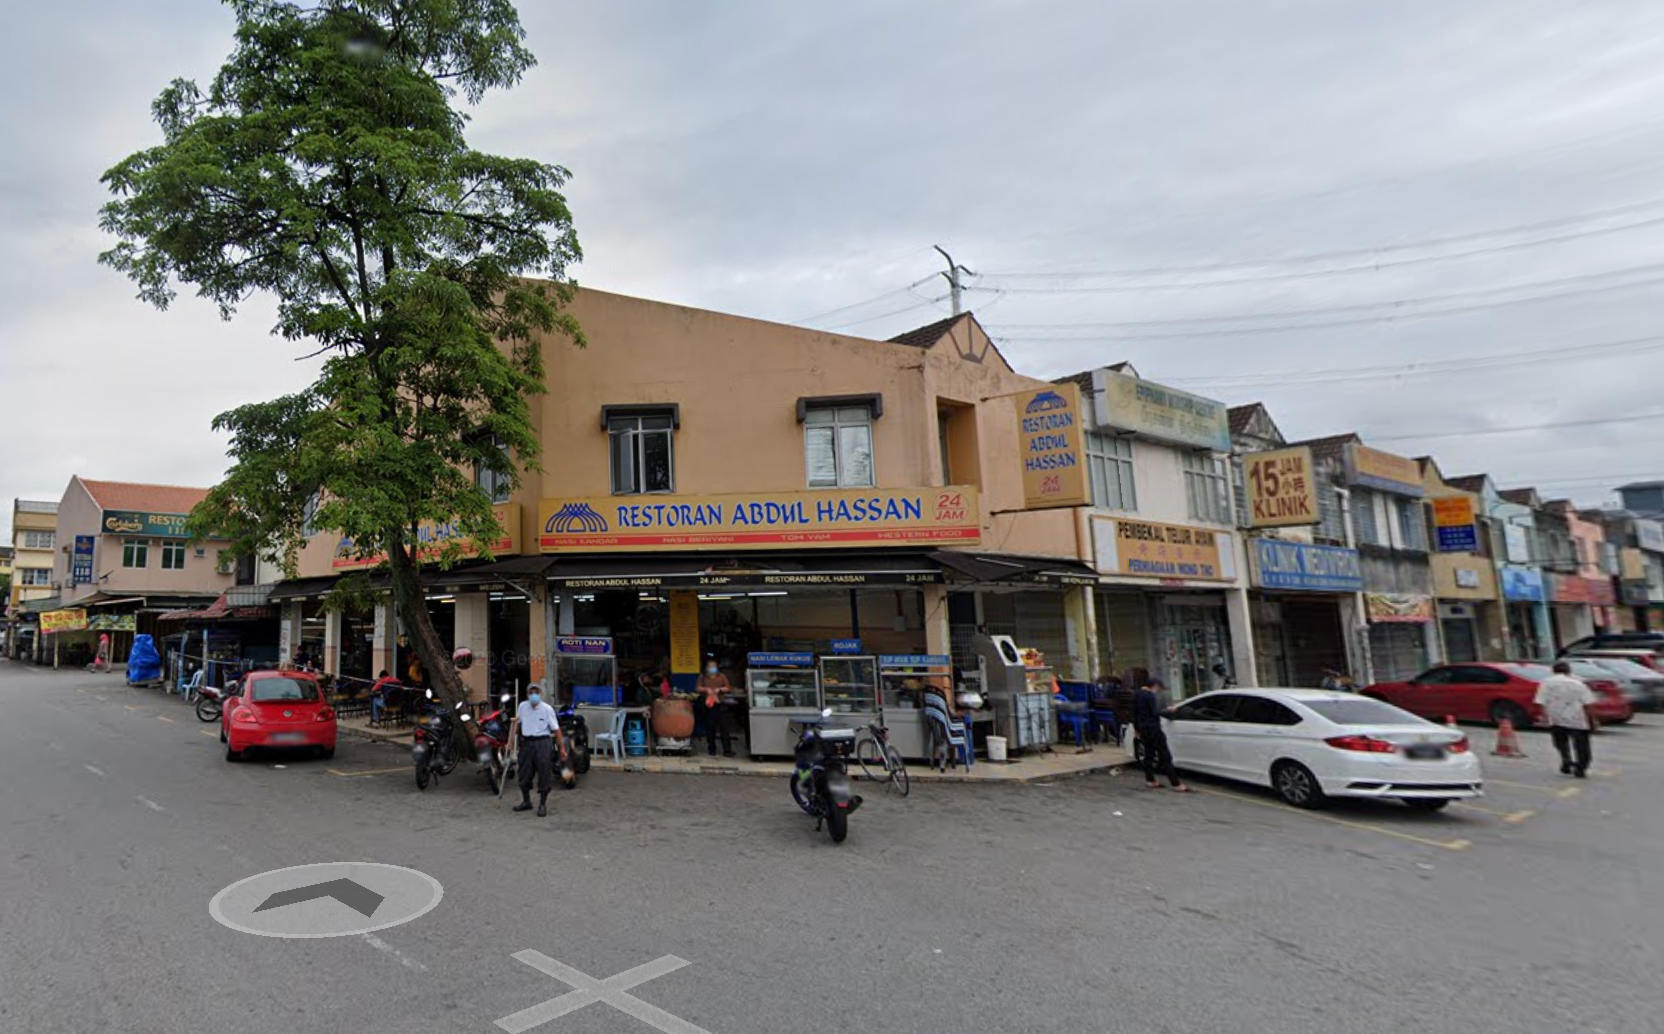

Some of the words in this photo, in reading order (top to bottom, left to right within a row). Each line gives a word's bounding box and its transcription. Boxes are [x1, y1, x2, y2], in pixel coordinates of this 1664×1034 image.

[1022, 412, 1073, 433] RESTORAN
[1029, 433, 1068, 452] ABDUL
[1025, 452, 1076, 471] HASSAN
[1249, 460, 1280, 498] 15
[1280, 457, 1304, 475] JAM
[937, 494, 962, 508] 24
[1253, 494, 1311, 519] KLINIK
[616, 503, 722, 528] RESTORAN
[731, 501, 810, 526] ABDUL
[816, 497, 922, 523] HASSAN
[934, 510, 965, 521] JAM
[932, 530, 962, 538] FOOD
[565, 580, 605, 588] RESTORAN
[605, 579, 630, 587] ABDUL
[631, 578, 662, 586] HASSAN
[765, 575, 806, 583] RESTORAN
[833, 574, 865, 582] HASSAN
